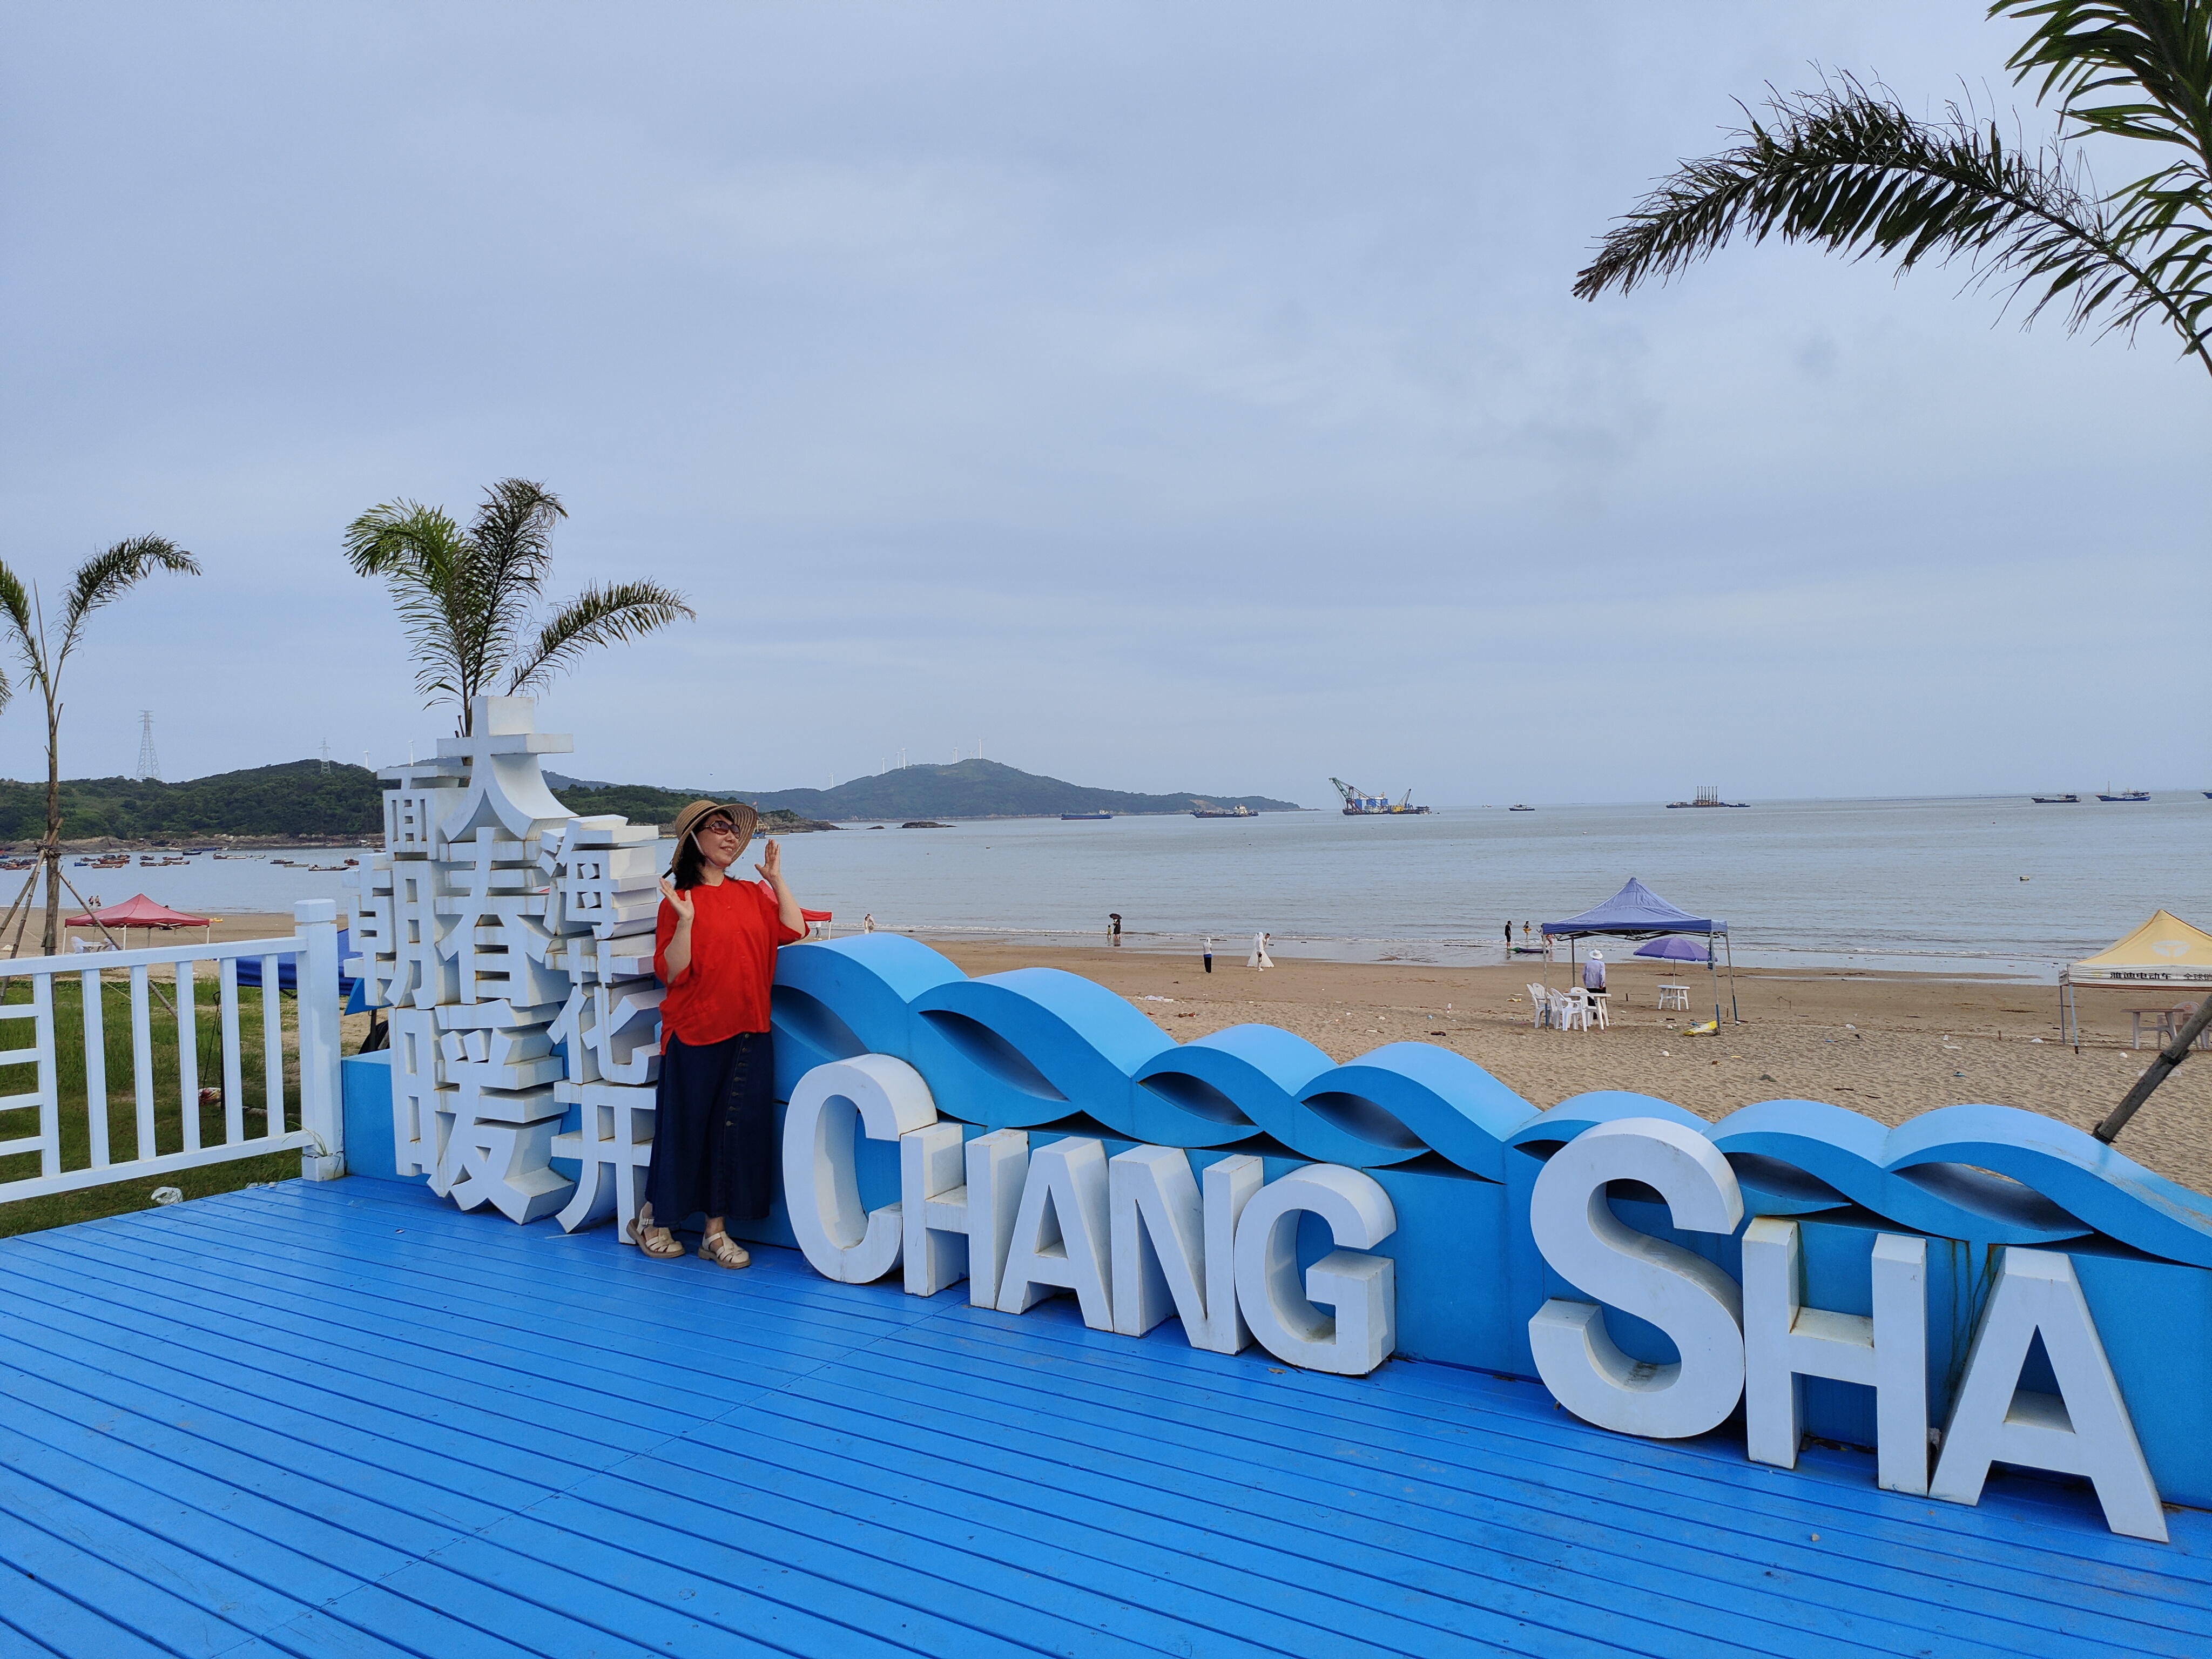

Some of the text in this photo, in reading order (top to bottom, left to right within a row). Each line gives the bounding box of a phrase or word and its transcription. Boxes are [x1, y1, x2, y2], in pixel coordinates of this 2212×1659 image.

[2109, 972, 2172, 980] 雅迪电动车
[782, 1053, 2170, 1543] CHANG SHA
